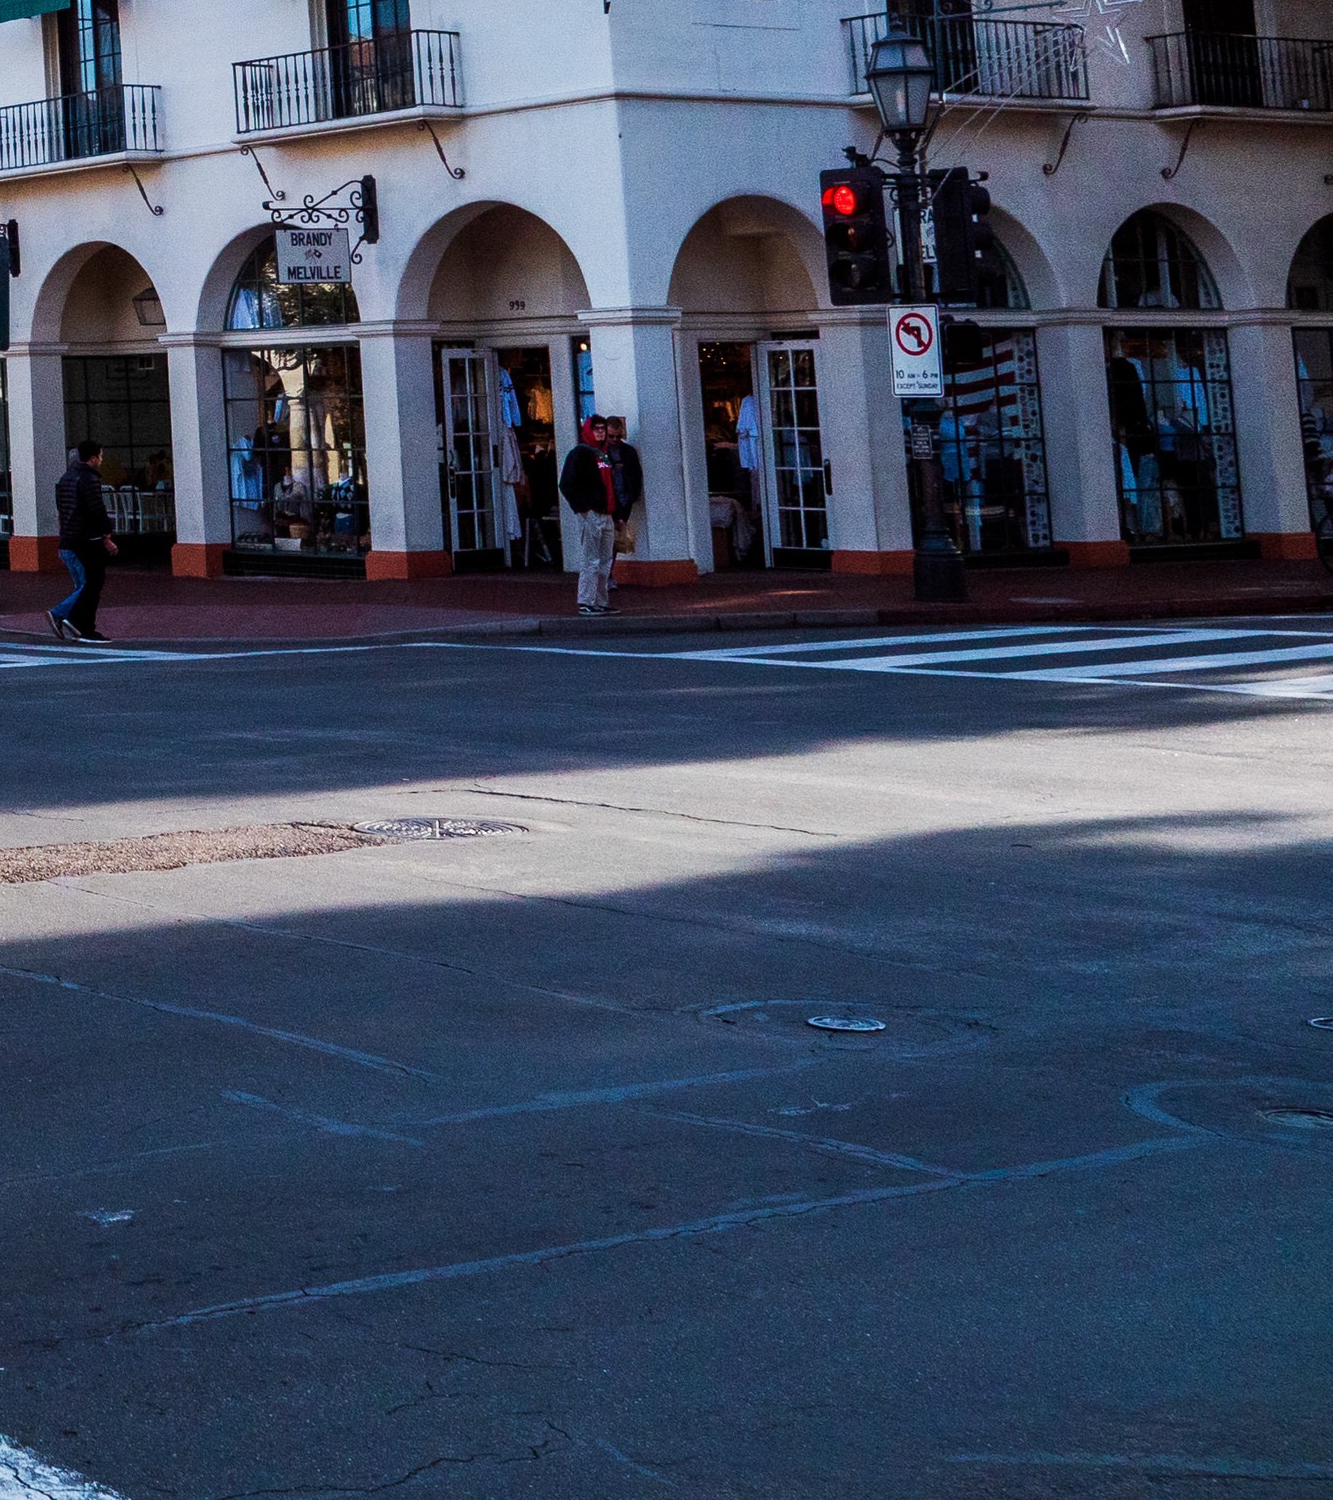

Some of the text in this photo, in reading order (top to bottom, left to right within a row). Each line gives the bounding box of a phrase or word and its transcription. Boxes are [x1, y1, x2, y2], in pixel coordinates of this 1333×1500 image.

[290, 232, 332, 246] BRANDY
[288, 266, 342, 280] MELVILLE
[896, 370, 904, 379] 10
[923, 370, 928, 379] 6
